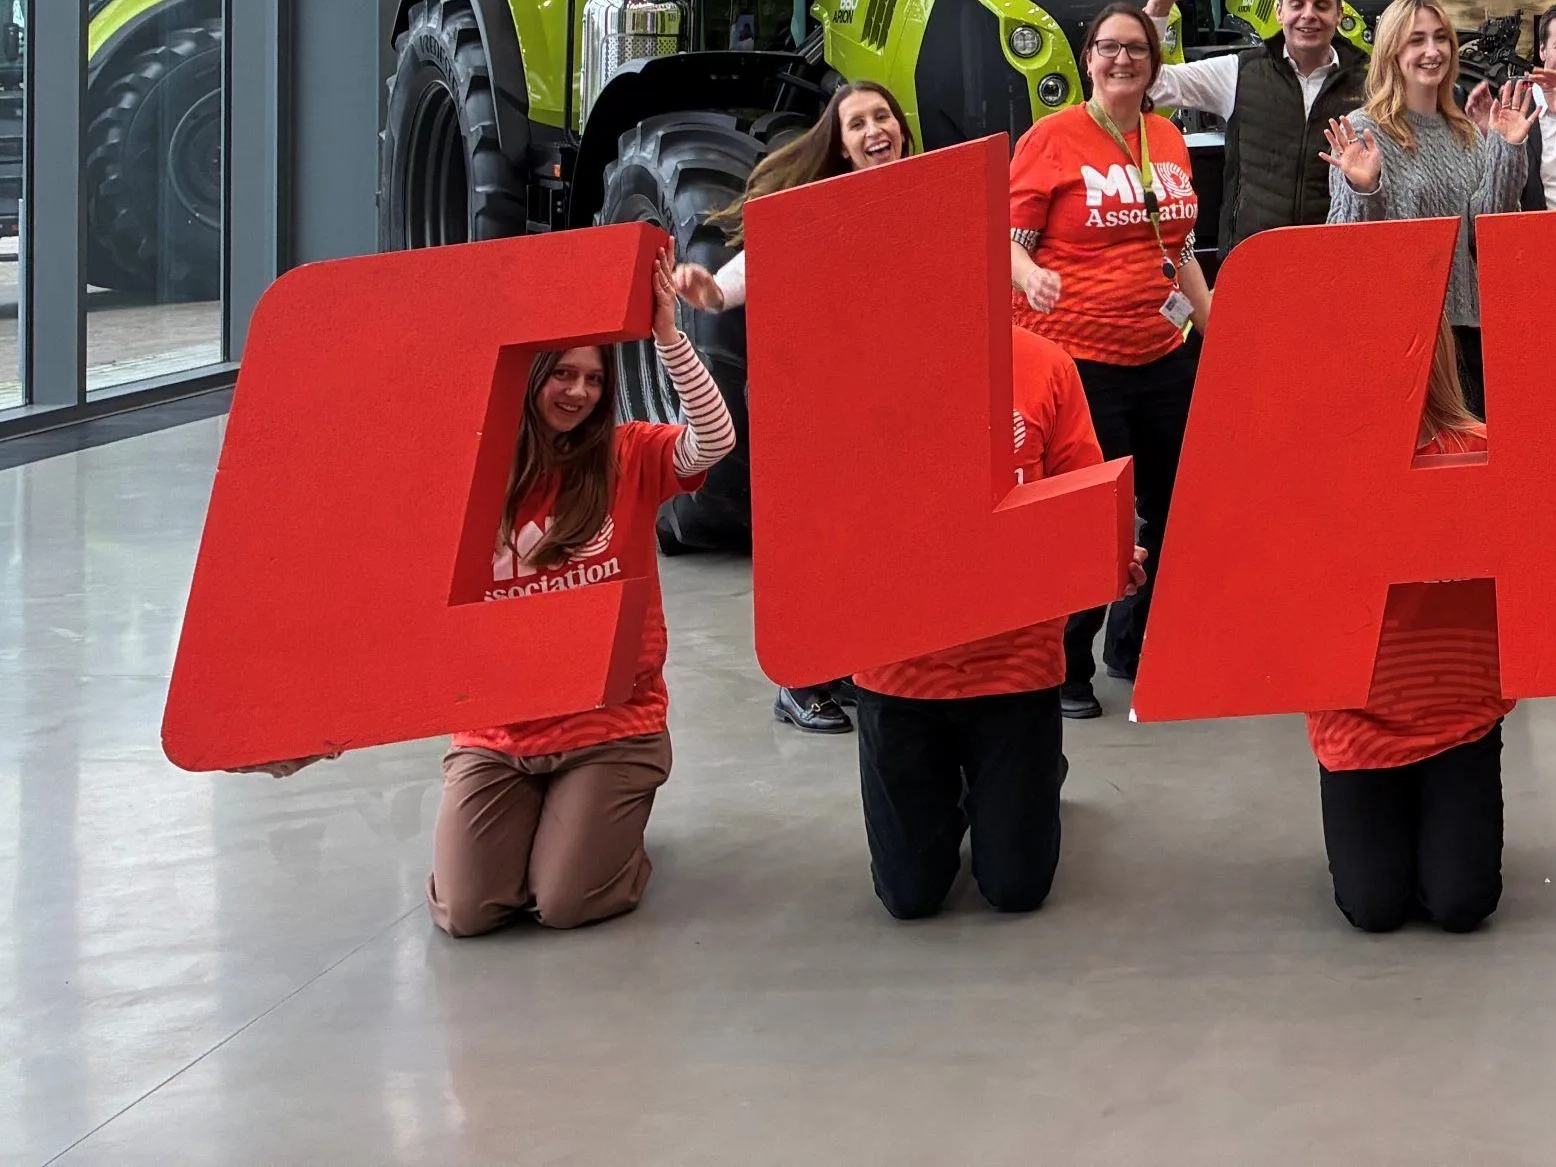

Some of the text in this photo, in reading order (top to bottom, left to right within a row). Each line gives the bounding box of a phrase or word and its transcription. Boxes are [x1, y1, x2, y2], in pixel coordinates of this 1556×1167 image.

[832, 9, 855, 24] ARION
[1080, 161, 1194, 207] MND
[1085, 200, 1198, 228] Assocatio
[484, 556, 622, 602] sociation
